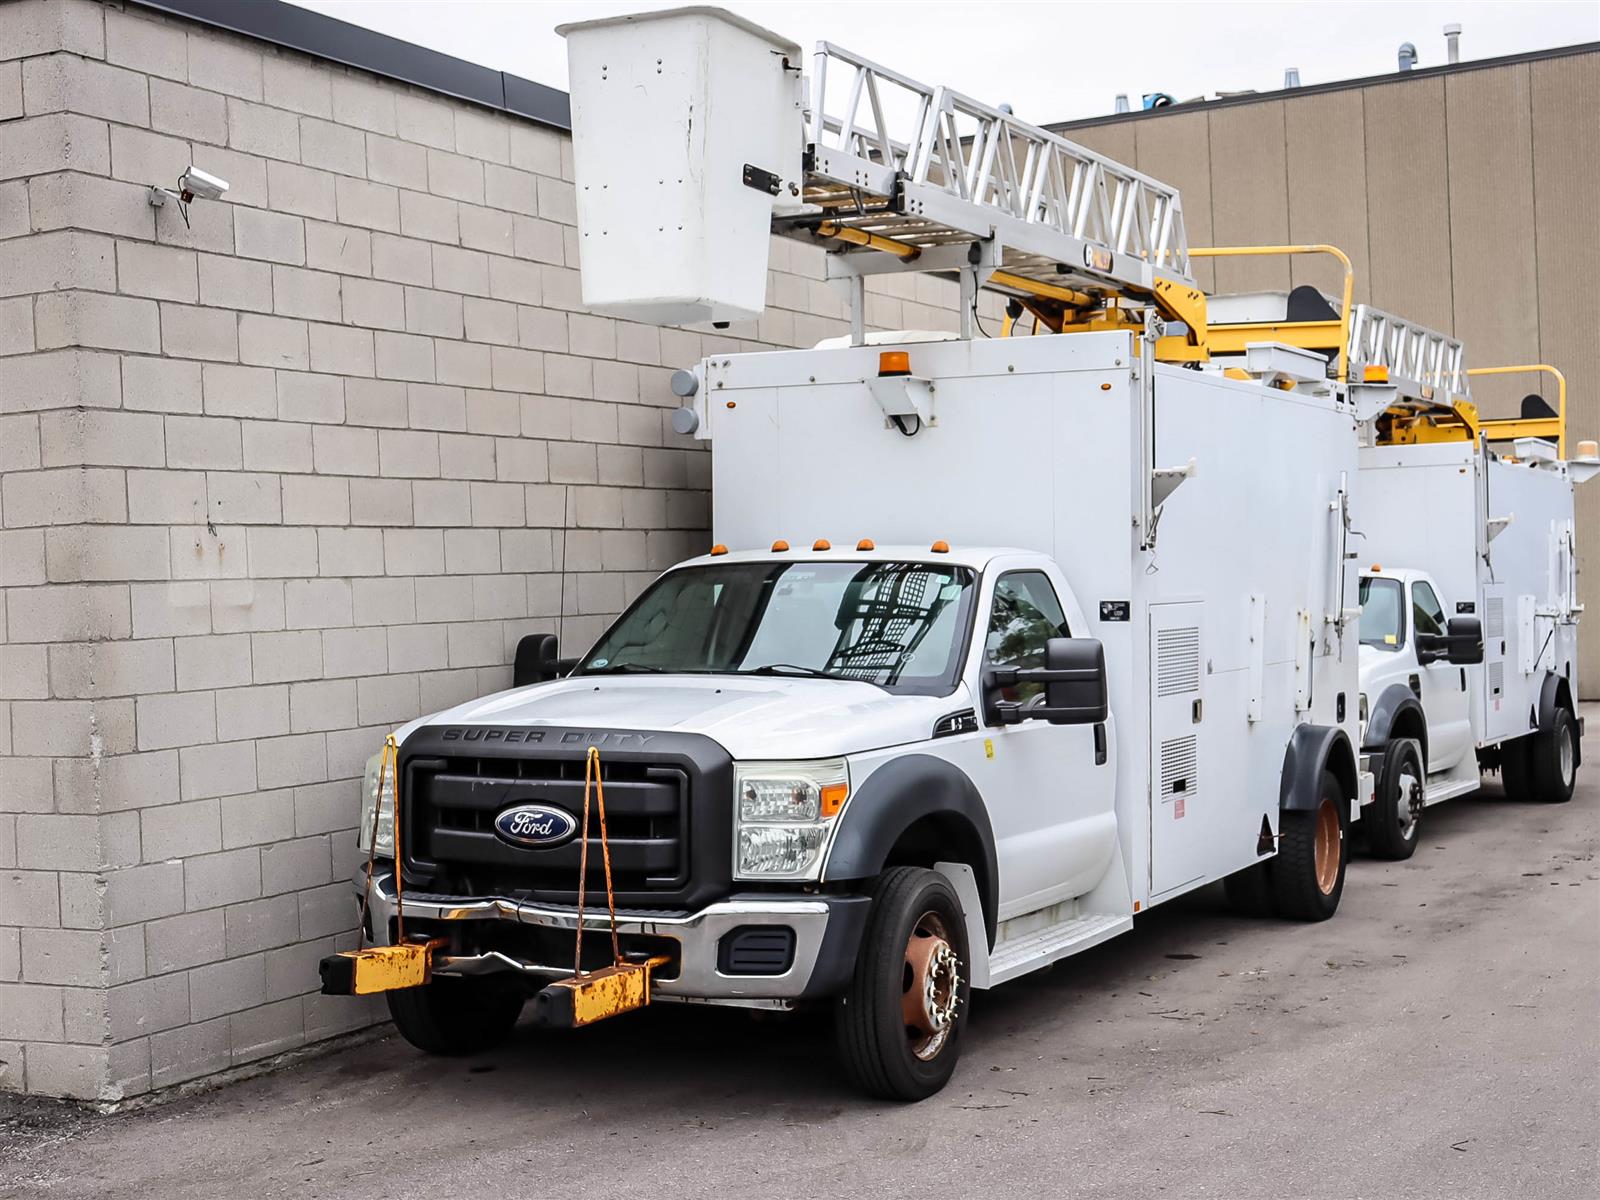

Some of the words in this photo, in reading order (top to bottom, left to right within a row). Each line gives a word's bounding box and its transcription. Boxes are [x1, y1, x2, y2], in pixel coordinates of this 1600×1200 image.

[441, 729, 546, 744] SUPER
[559, 731, 655, 746] DUTY
[510, 811, 554, 835] Ford
